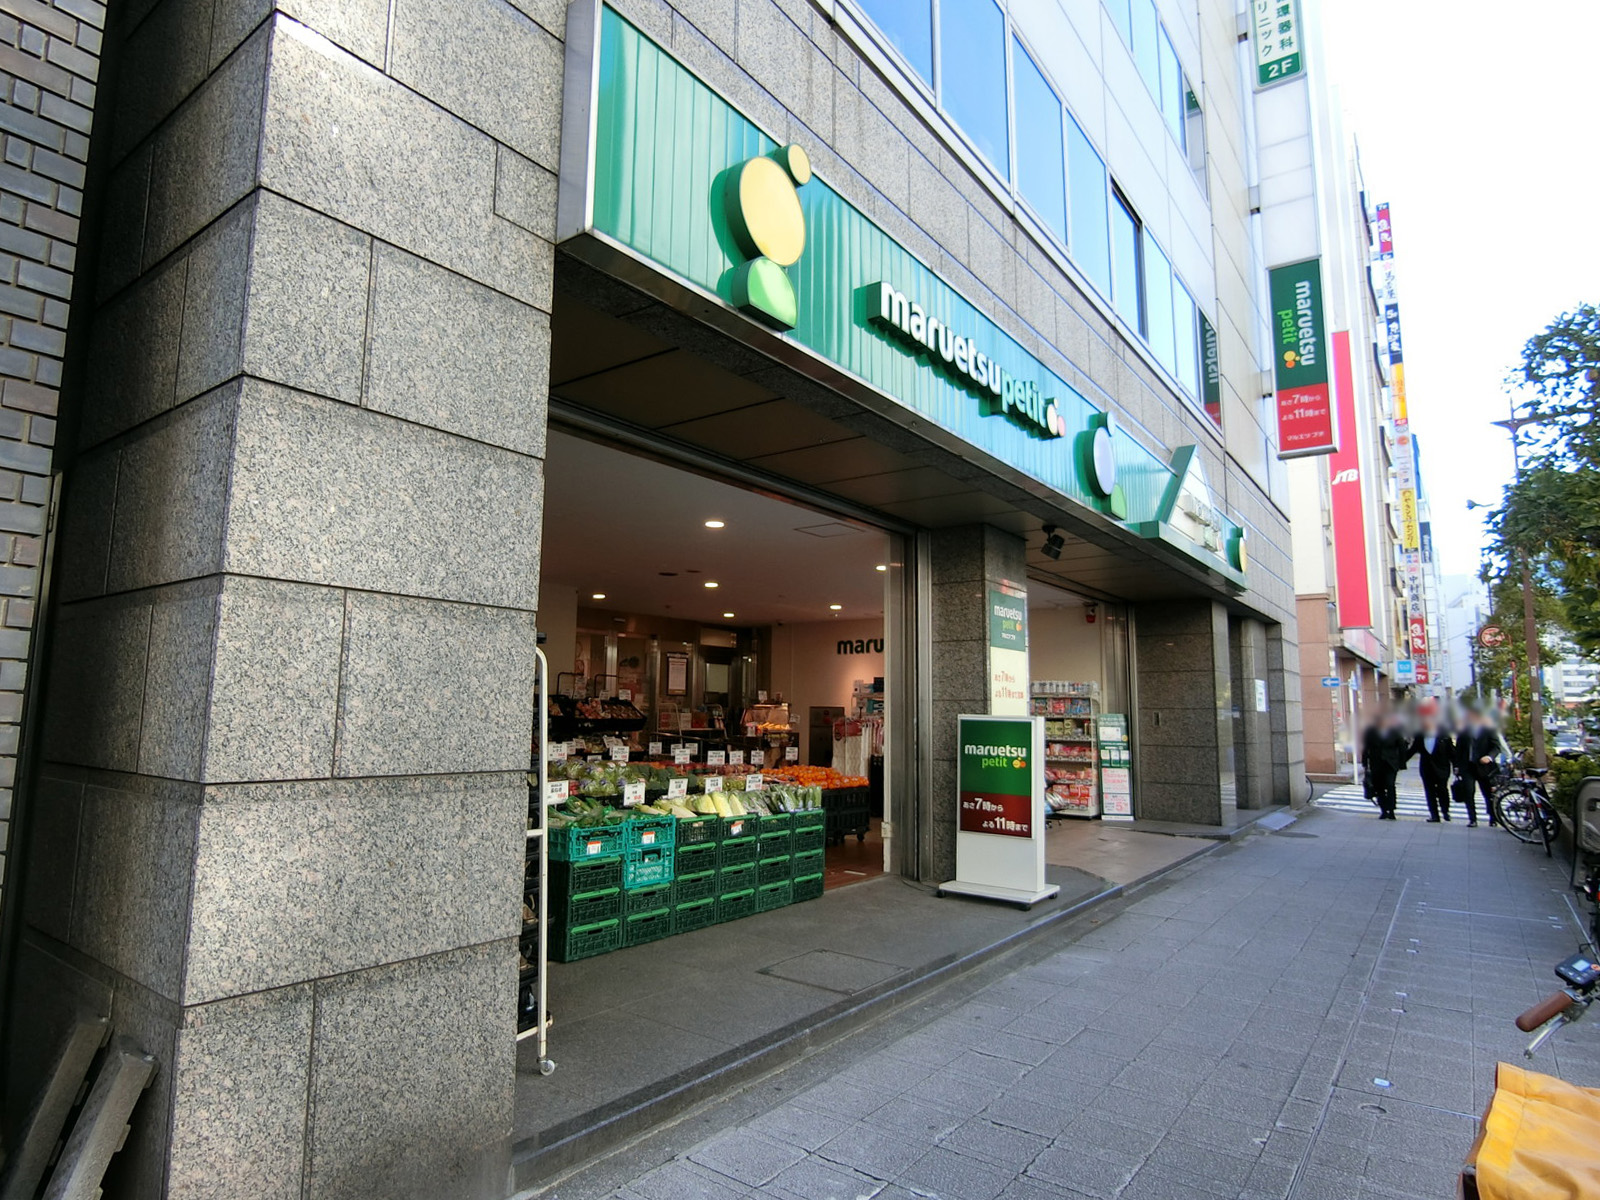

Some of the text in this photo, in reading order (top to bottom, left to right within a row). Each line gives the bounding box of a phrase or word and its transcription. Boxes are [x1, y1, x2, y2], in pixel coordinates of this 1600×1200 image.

[1268, 59, 1293, 79] 2F
[1277, 309, 1297, 344] petit
[1295, 280, 1316, 366] maruetsu
[881, 282, 1047, 428] maruetsu petit
[1331, 468, 1358, 485] JTB
[994, 605, 1022, 620] maruetsu
[837, 638, 884, 654] maru
[964, 744, 1027, 757] maruetsu
[982, 757, 1008, 769] petit
[963, 797, 1004, 813] あさ7時から
[982, 816, 1028, 831] よる11時まで
